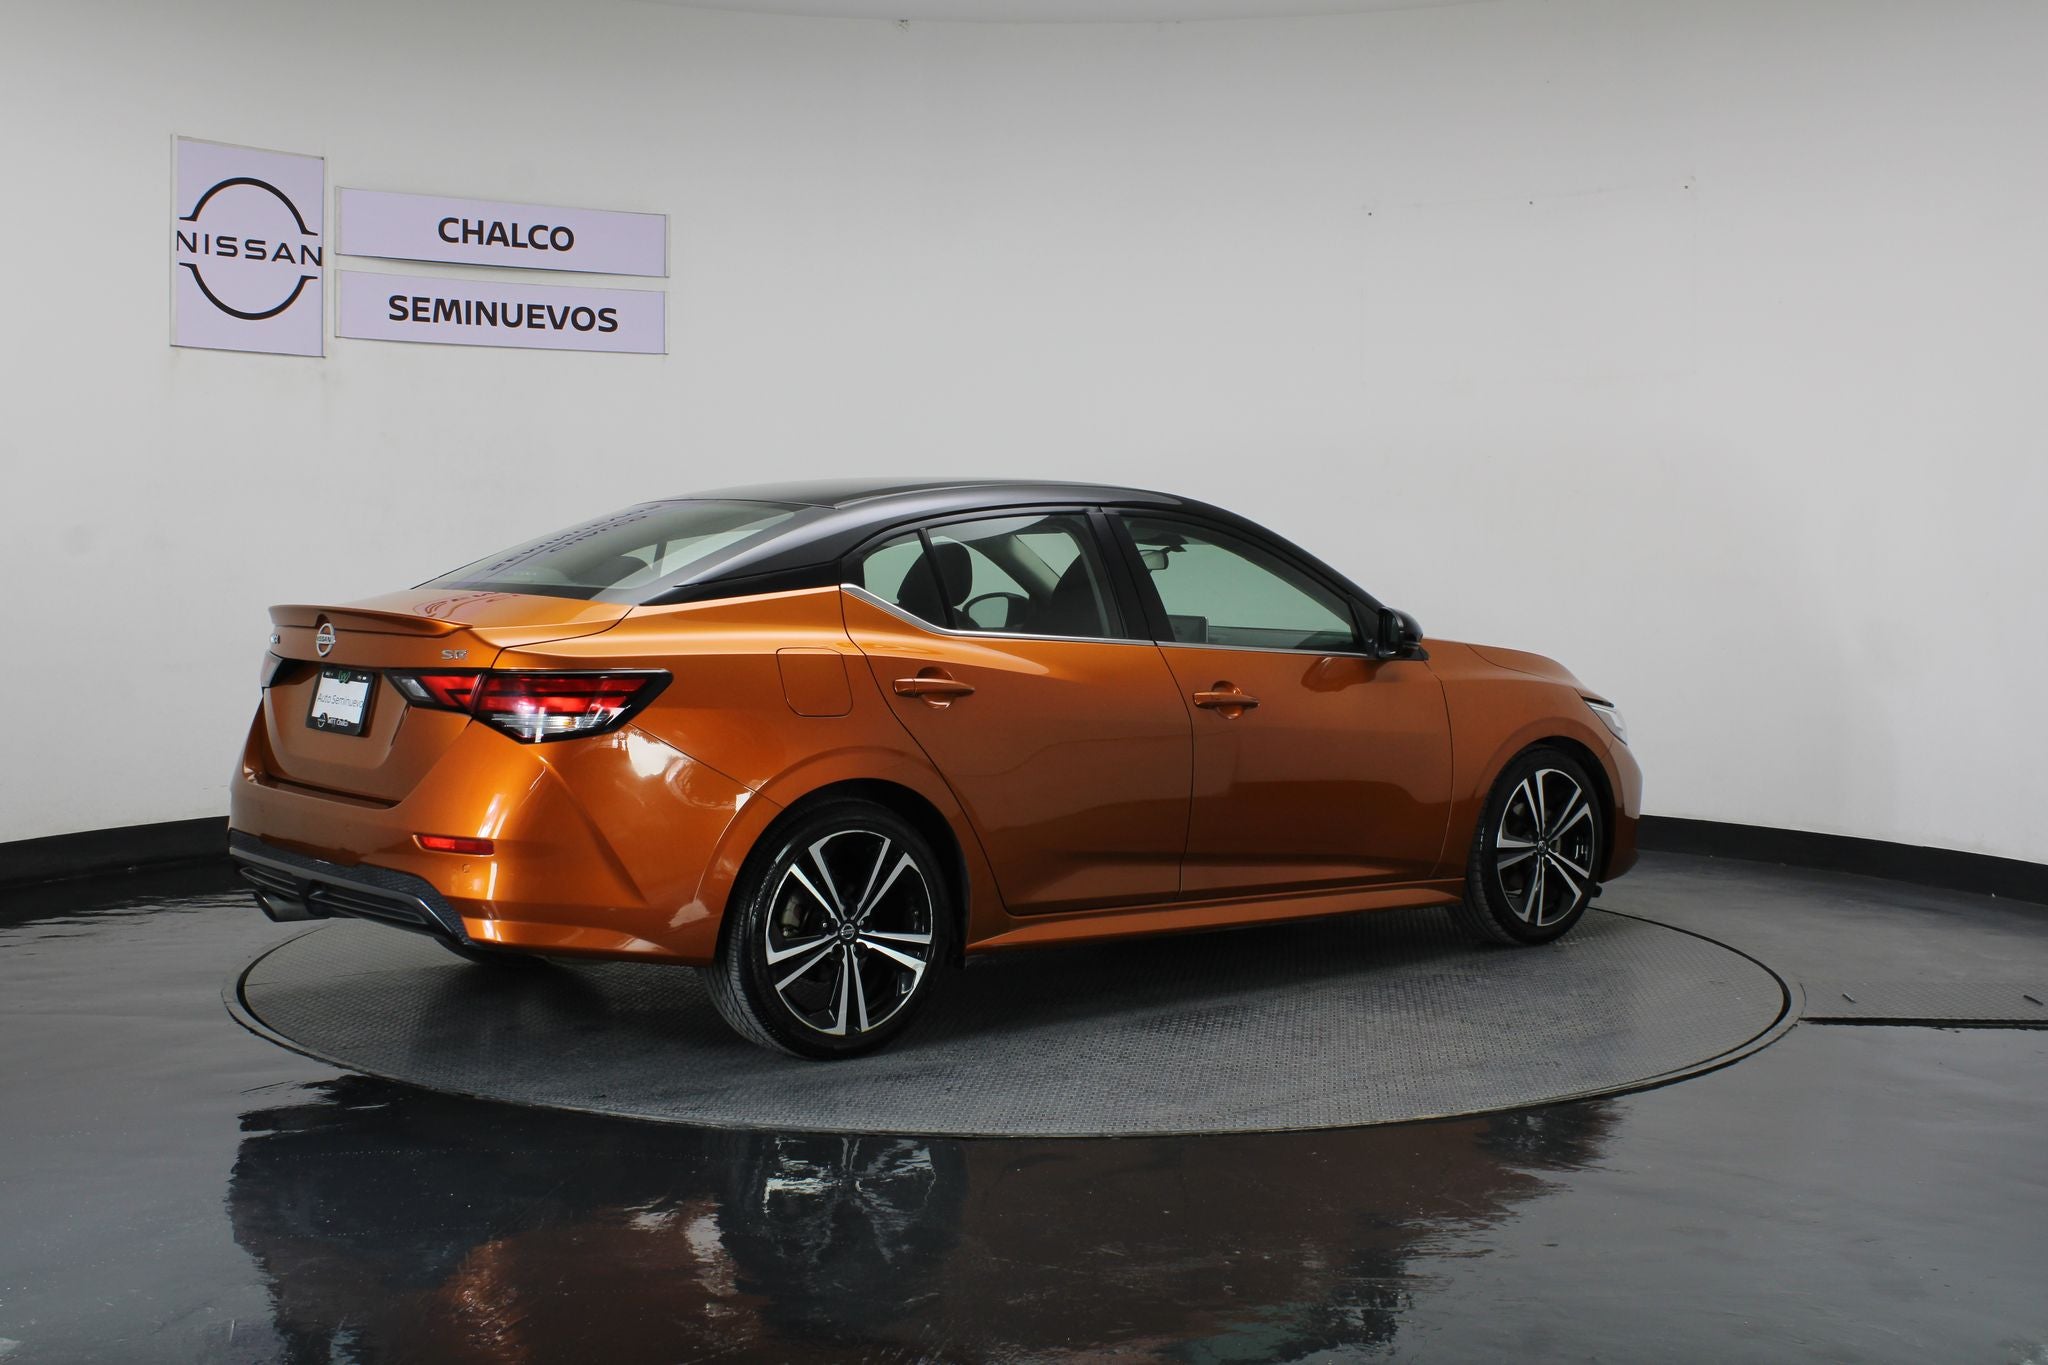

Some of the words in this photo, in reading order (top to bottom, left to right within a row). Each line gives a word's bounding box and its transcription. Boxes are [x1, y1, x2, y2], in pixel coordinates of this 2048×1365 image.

[176, 230, 323, 267] NISSAN
[438, 217, 575, 251] CHALCO
[388, 295, 619, 333] SEMINUEVOS
